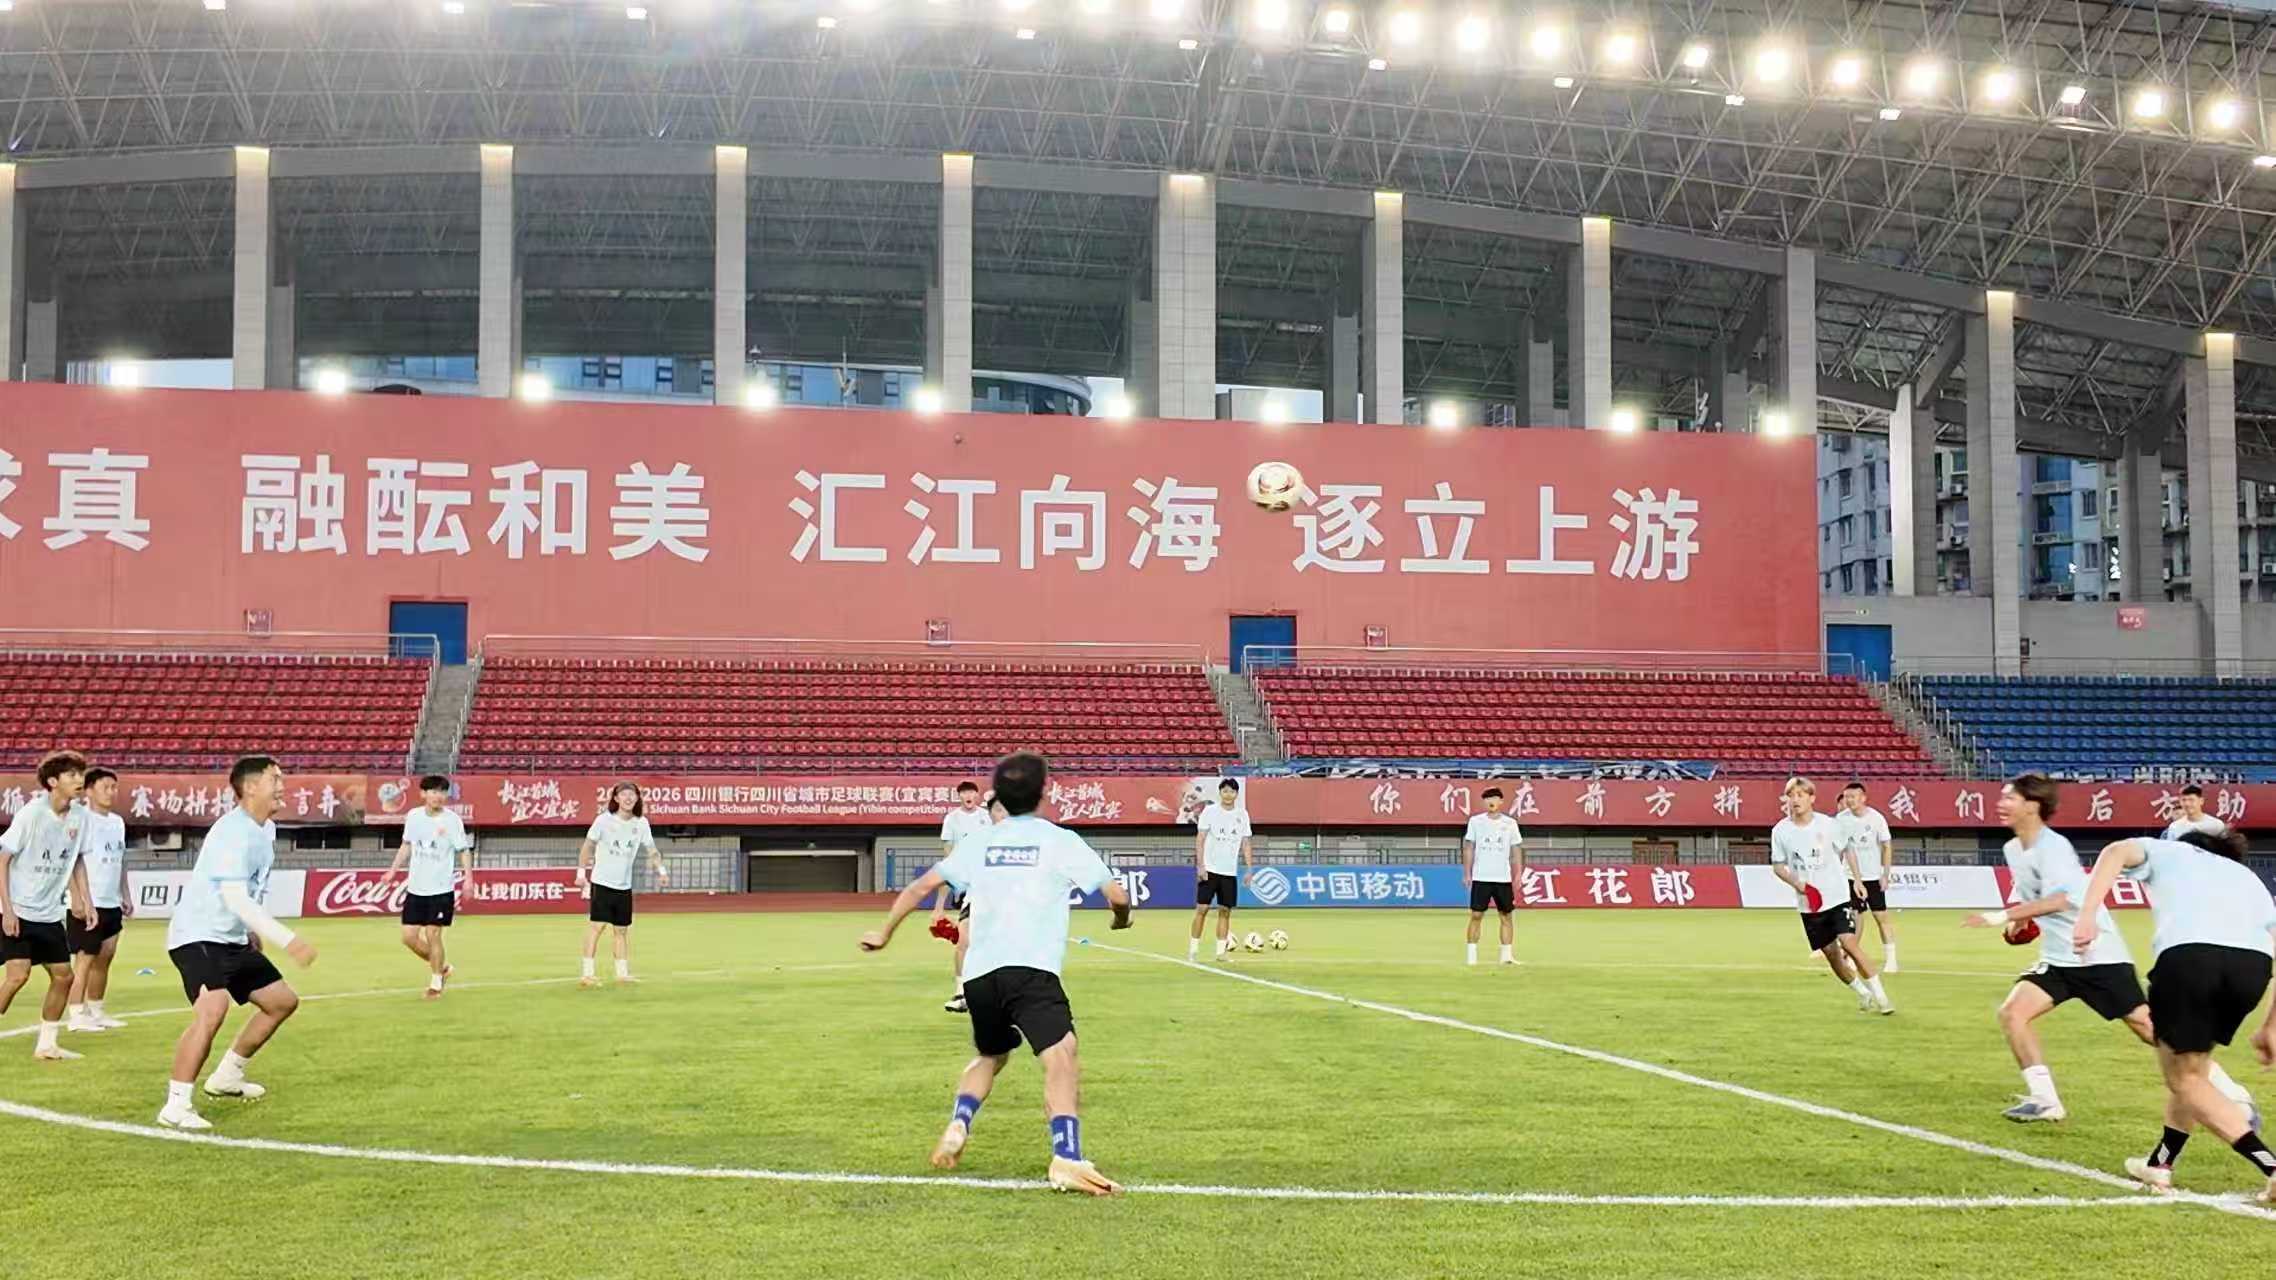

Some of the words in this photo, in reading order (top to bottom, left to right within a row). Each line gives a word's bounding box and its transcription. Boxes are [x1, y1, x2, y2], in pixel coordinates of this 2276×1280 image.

[241, 454, 710, 563] 融酝和美
[788, 470, 1220, 572] 汇江向海
[1292, 481, 1701, 582] 逐立上游
[650, 803, 690, 814] Sichuan
[692, 803, 717, 814] Bank
[719, 803, 758, 814] Sichuan
[760, 803, 780, 816] City
[781, 803, 821, 814] Football
[823, 804, 857, 816] League
[888, 803, 946, 816] competition
[1296, 871, 1425, 900] 中国移动
[1521, 867, 1695, 905] 红花郎
